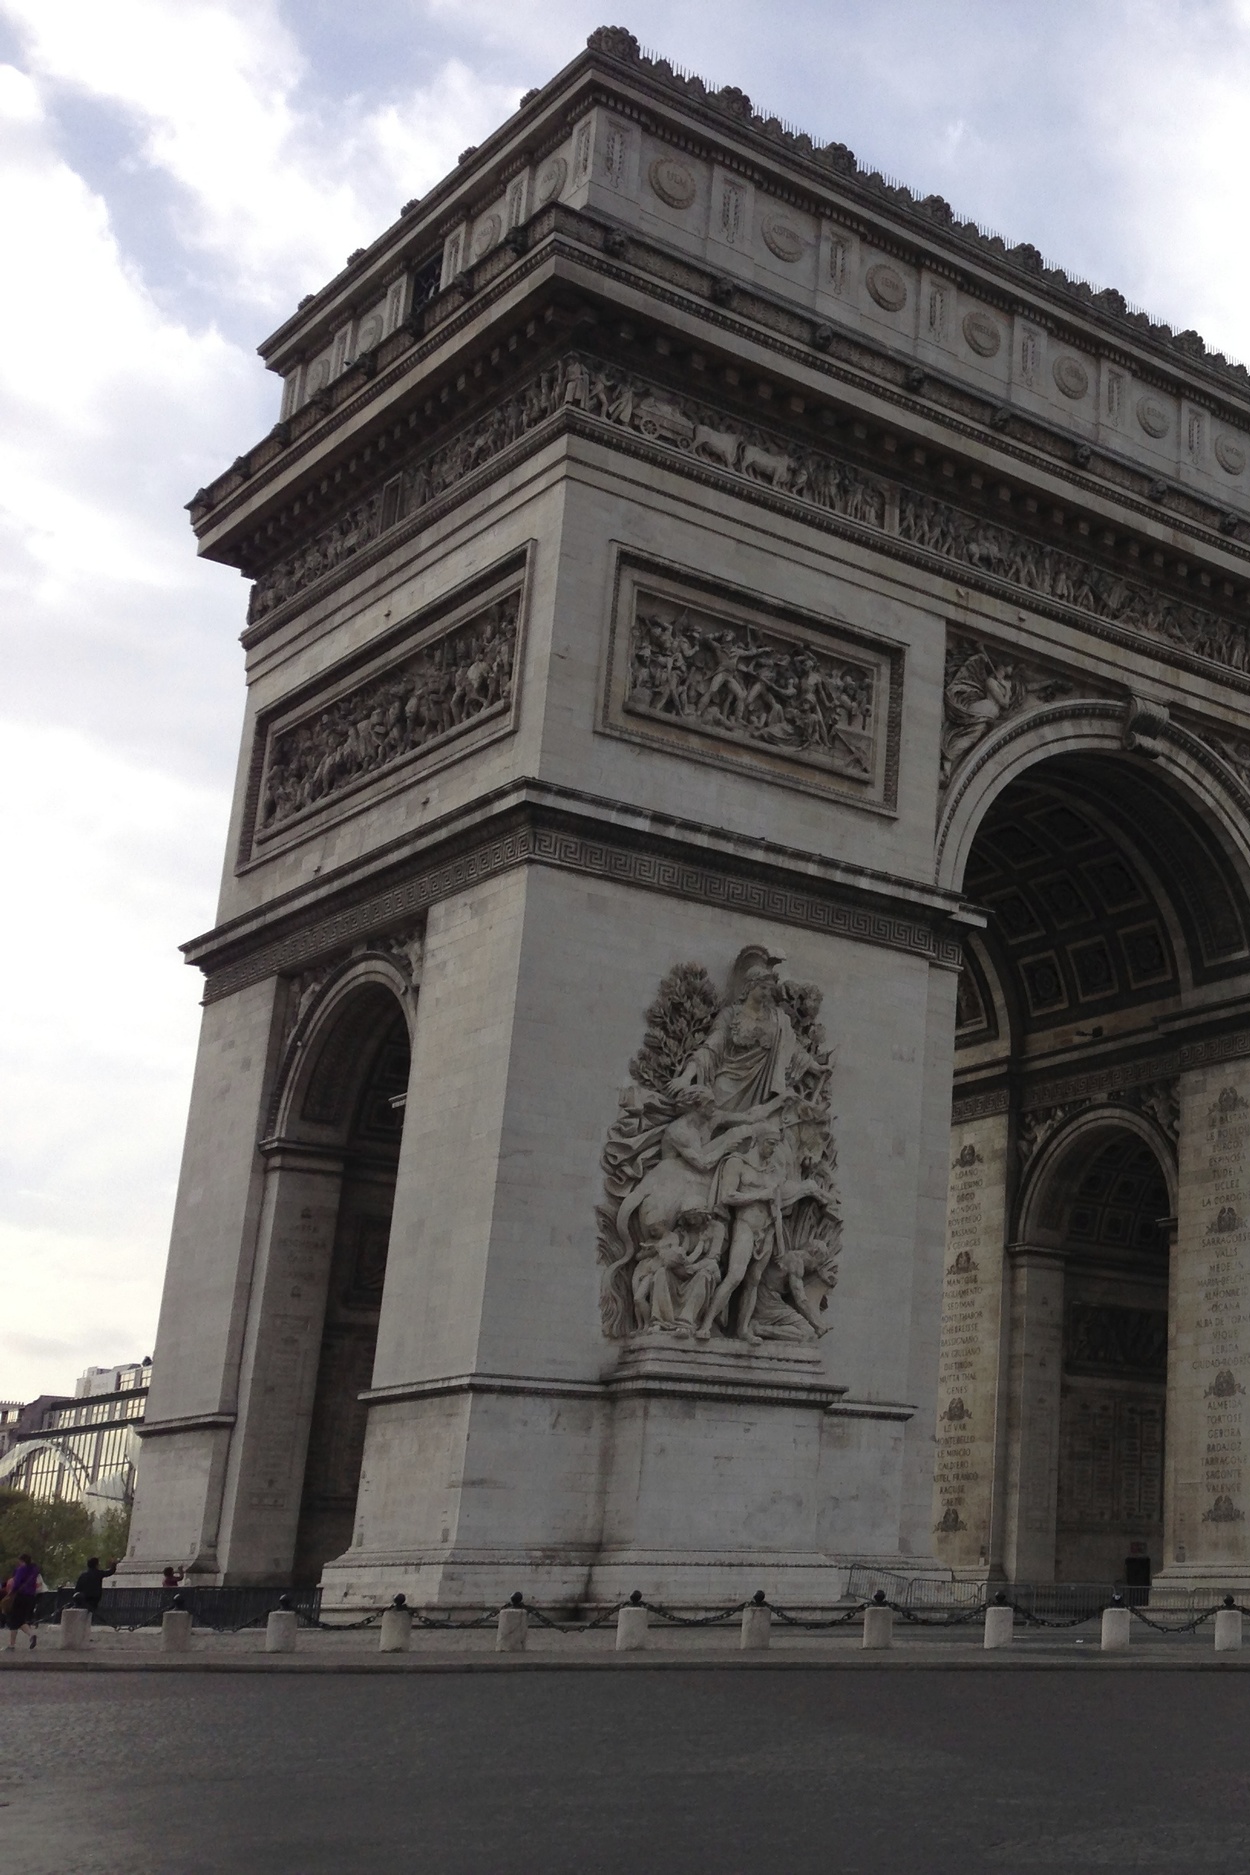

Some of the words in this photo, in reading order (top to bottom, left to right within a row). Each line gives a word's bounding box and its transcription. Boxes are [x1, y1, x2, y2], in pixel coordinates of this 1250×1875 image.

[1206, 1131, 1215, 1143] LE
[1212, 1140, 1243, 1153] BURGOS
[1208, 1152, 1246, 1167] ESPINOSA
[955, 1168, 979, 1180] LOANO
[1212, 1166, 1243, 1179] TUDELA
[1214, 1179, 1240, 1191] UCLEZ
[1201, 1198, 1212, 1208] LA
[951, 1226, 978, 1239] BASSANO
[1215, 1247, 1238, 1258] VALLS
[947, 1300, 976, 1311] SEDIMAN
[1195, 1317, 1213, 1328] ALBA
[1215, 1316, 1225, 1327] DE
[1212, 1329, 1240, 1341] VIQUE
[1211, 1343, 1239, 1355] LERIDA
[947, 1382, 969, 1395] GENES
[1207, 1399, 1242, 1411] ALMEIDA
[1207, 1413, 1243, 1425] TORTOSE
[943, 1424, 952, 1433] LE
[953, 1423, 967, 1432] VAR
[1206, 1441, 1242, 1453] BADAJOZ
[937, 1449, 945, 1459] LE
[1200, 1454, 1248, 1467] TARRAGONE
[1206, 1468, 1242, 1480] SAGONTE
